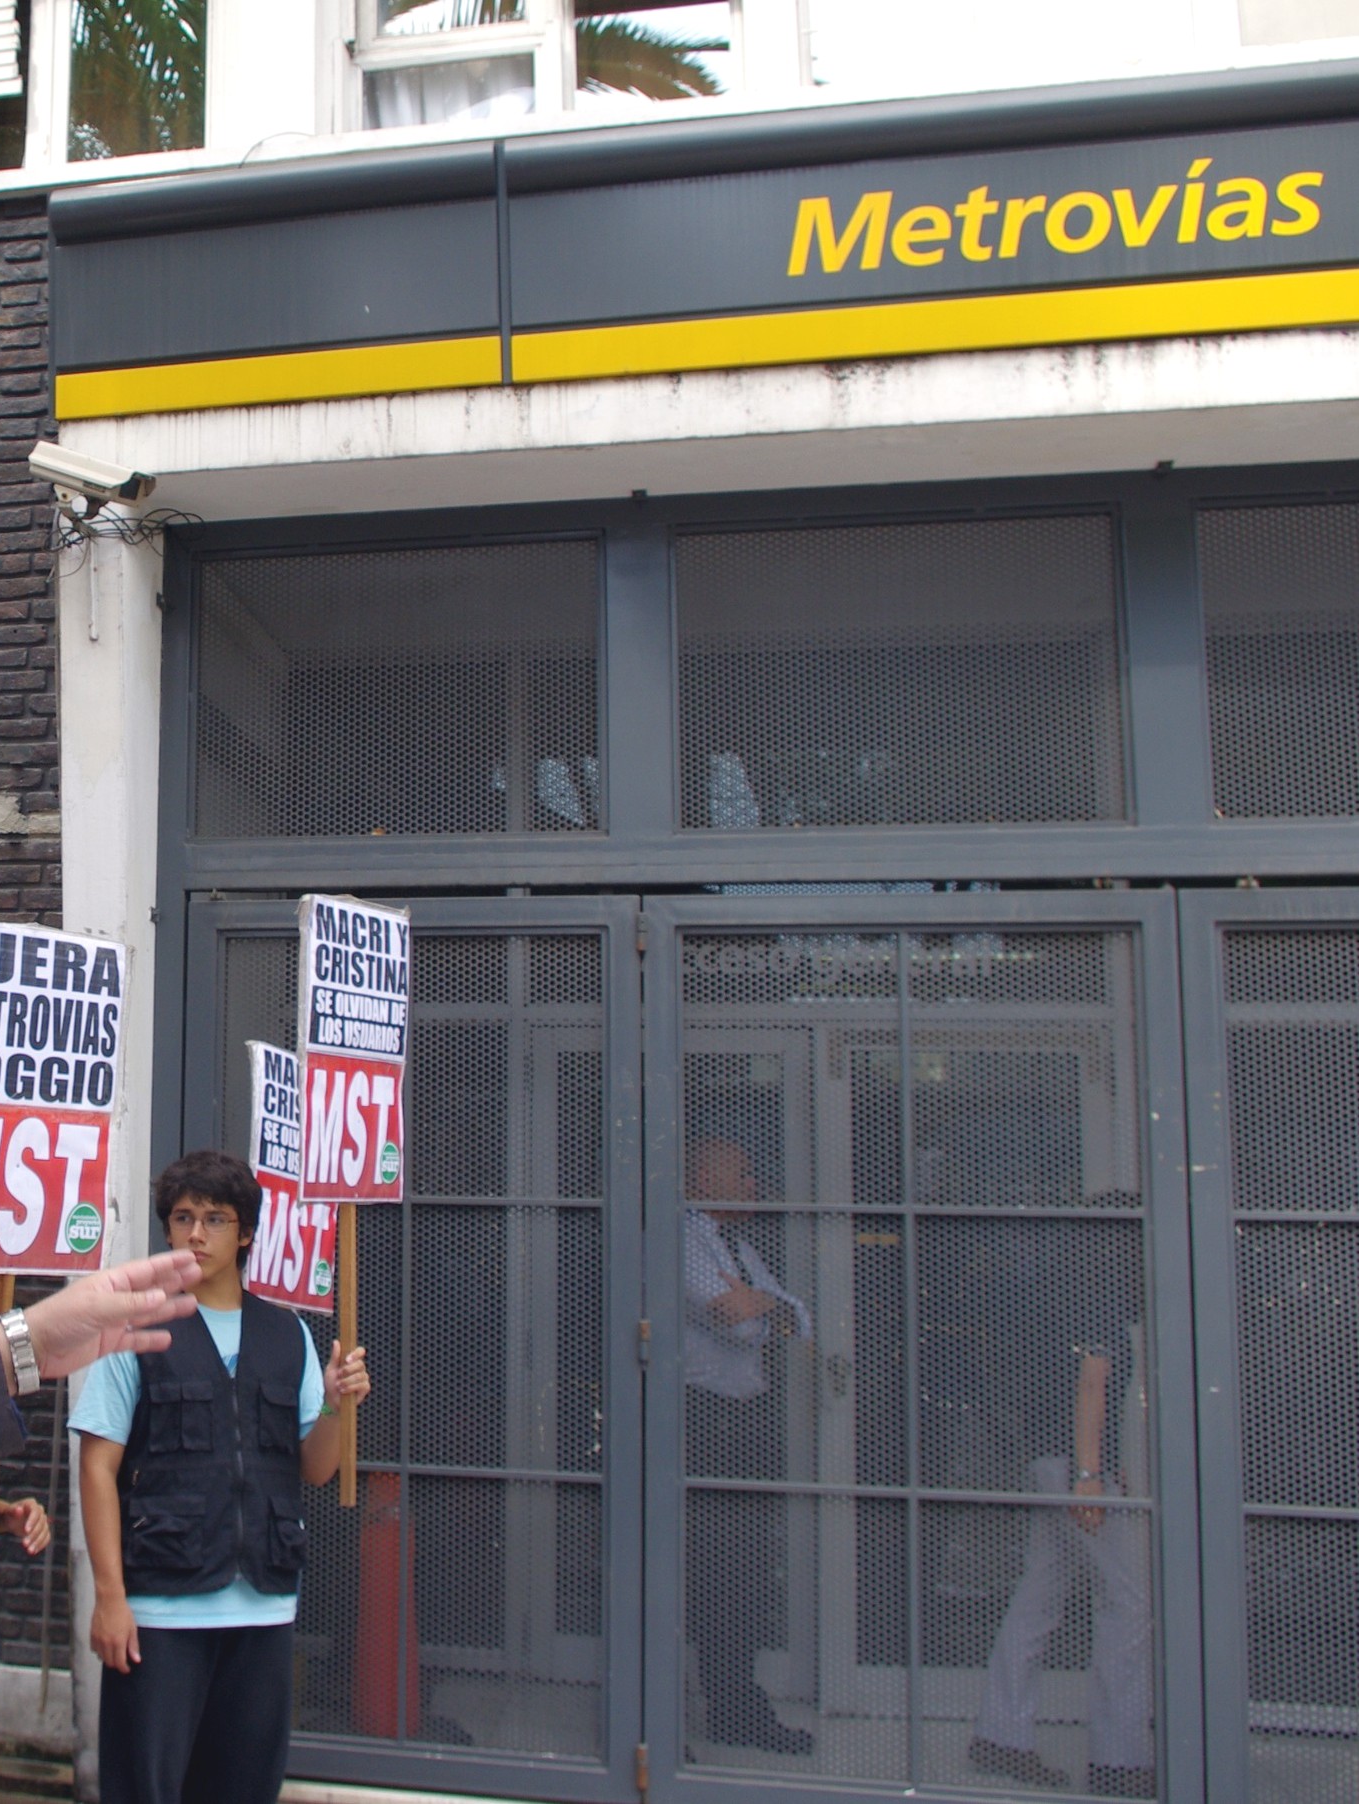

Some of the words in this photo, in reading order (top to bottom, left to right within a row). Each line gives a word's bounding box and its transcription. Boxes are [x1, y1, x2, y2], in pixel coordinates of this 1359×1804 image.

[787, 158, 1324, 277] Metrovías
[316, 903, 390, 955] MACRI
[397, 922, 408, 958] Y
[315, 943, 408, 997] CRISTINA
[315, 988, 334, 1016] SE
[335, 991, 390, 1025] OLVIDAN
[391, 1001, 407, 1026] DE
[317, 1015, 342, 1046] LOS
[344, 1019, 401, 1054] USUARIOS
[264, 1119, 279, 1144] SE
[305, 1068, 395, 1188] MST
[266, 1142, 287, 1170] LOS
[69, 1225, 100, 1240] sur
[250, 1188, 330, 1296] MST
